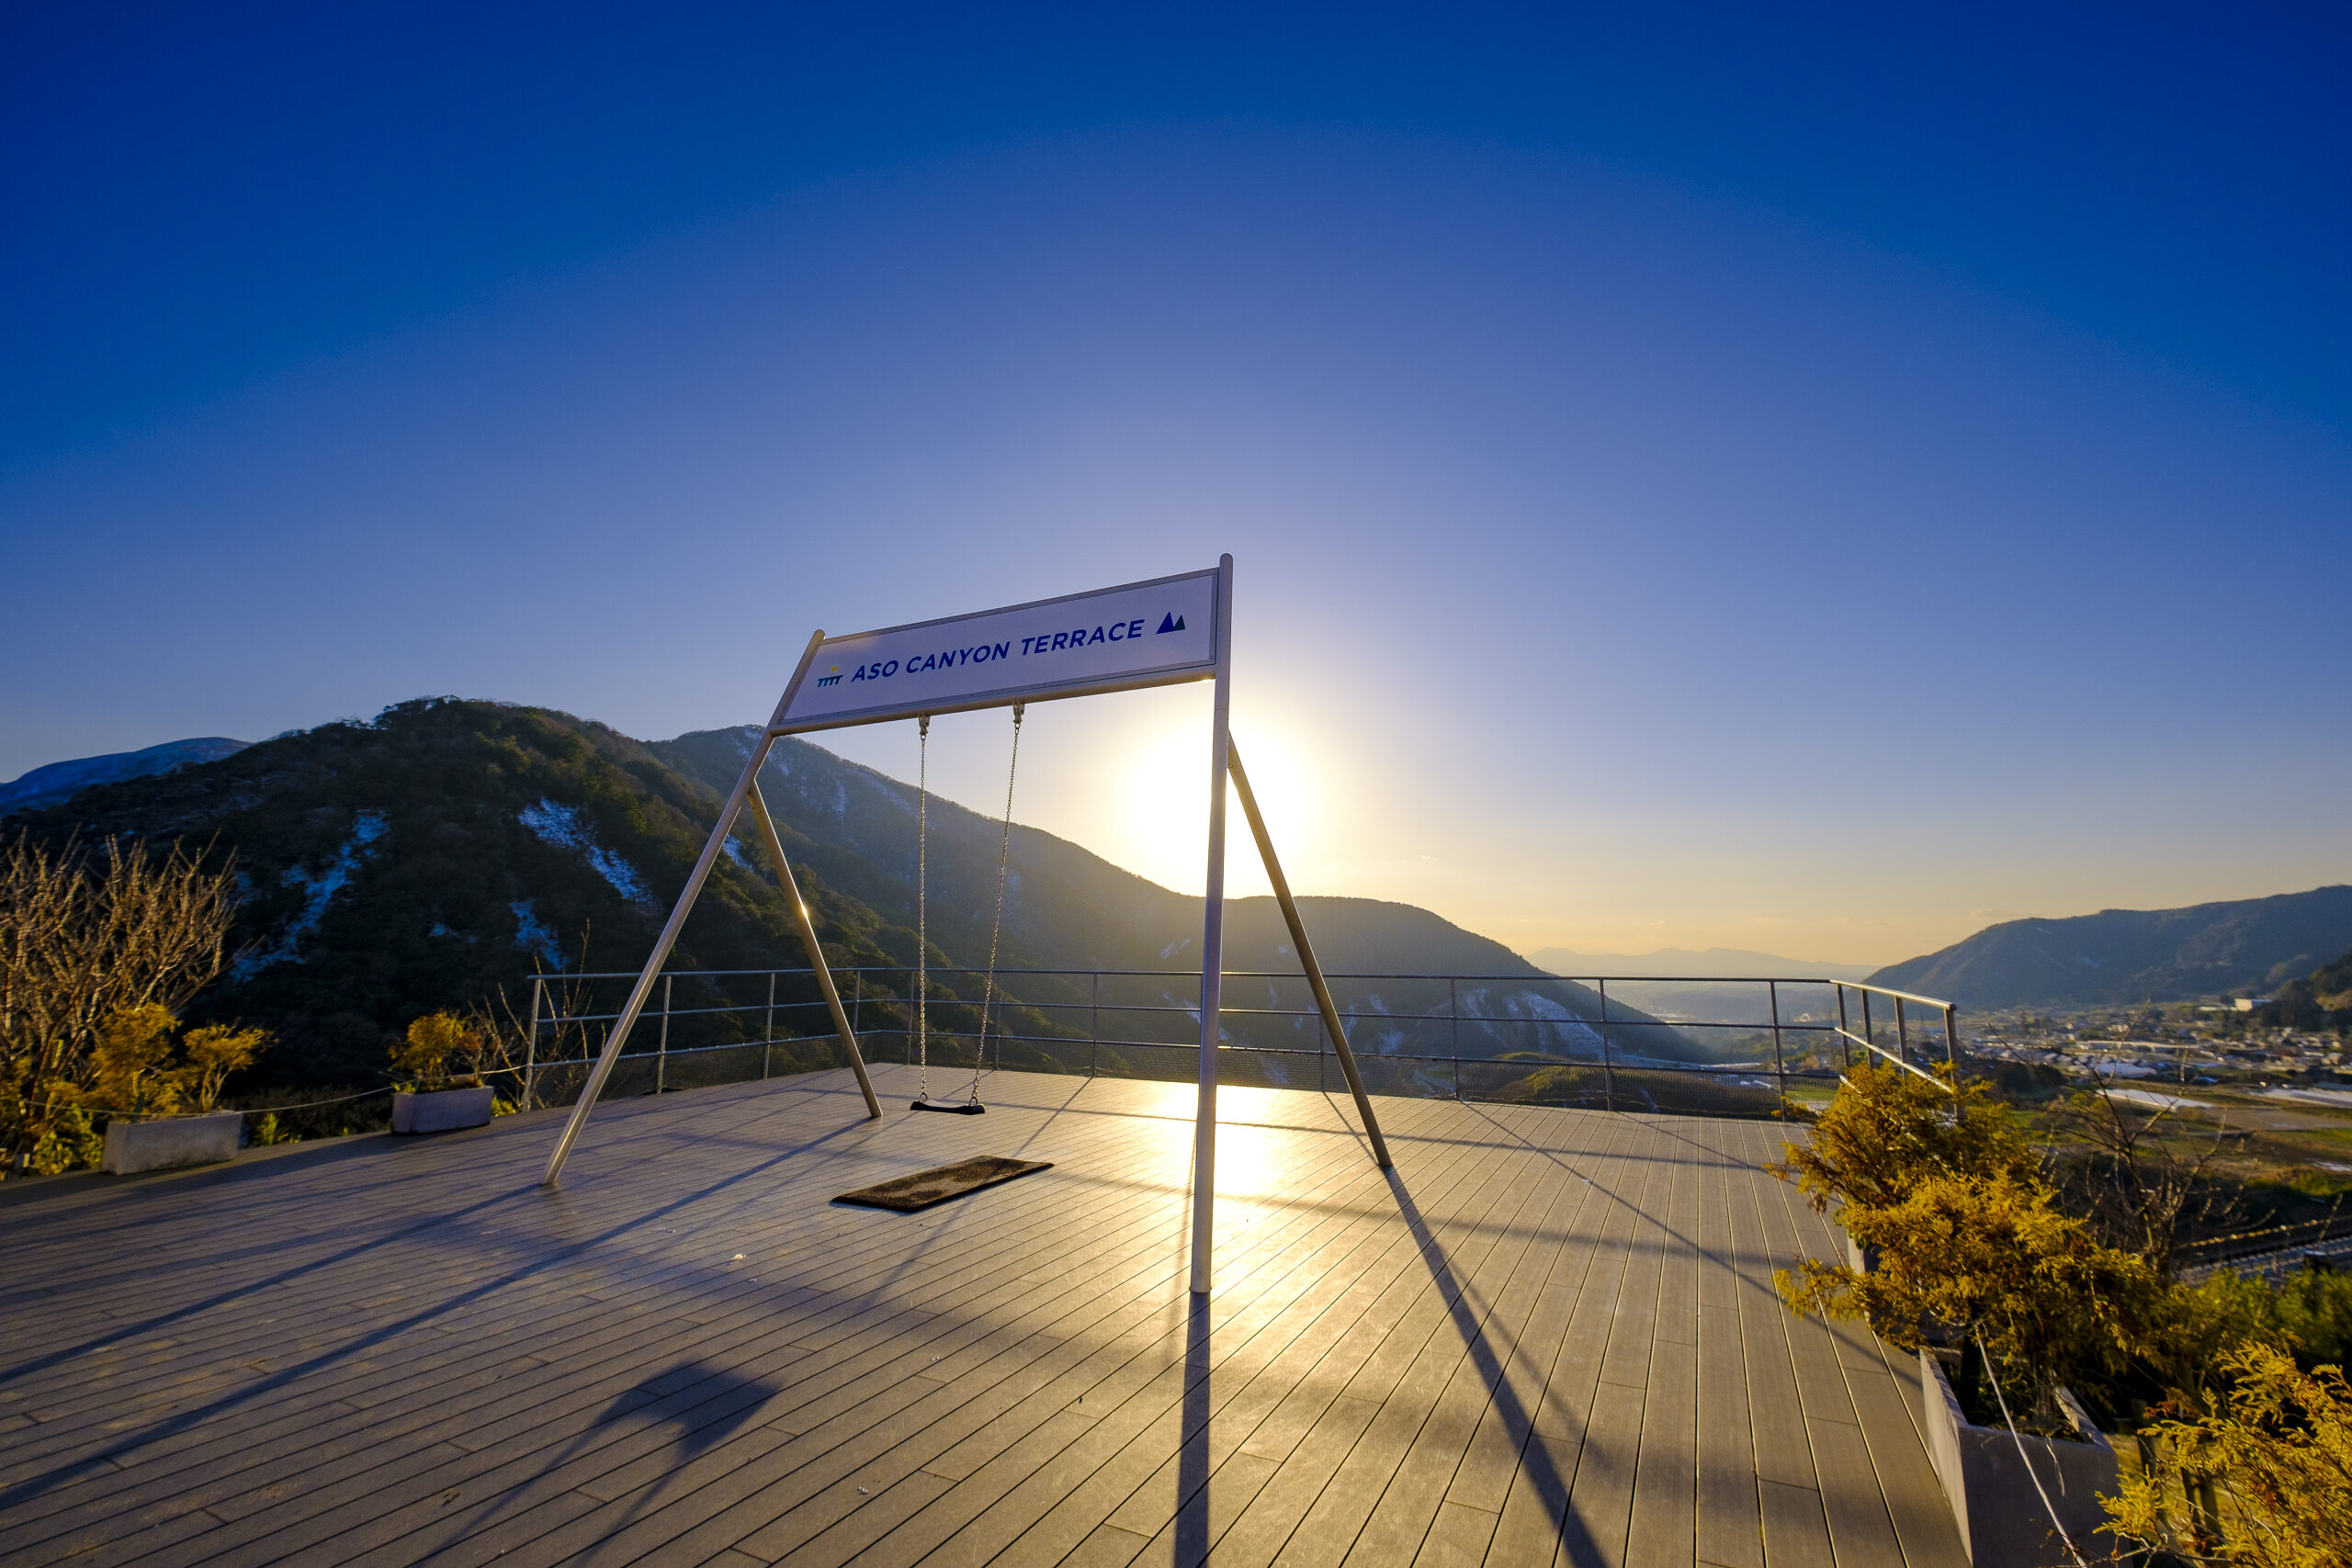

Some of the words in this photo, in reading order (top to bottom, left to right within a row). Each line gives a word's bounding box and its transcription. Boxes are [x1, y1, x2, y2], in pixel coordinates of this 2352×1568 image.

[851, 660, 899, 682] ASO
[906, 641, 1011, 673] CANYON
[1021, 619, 1145, 656] TERRACE
